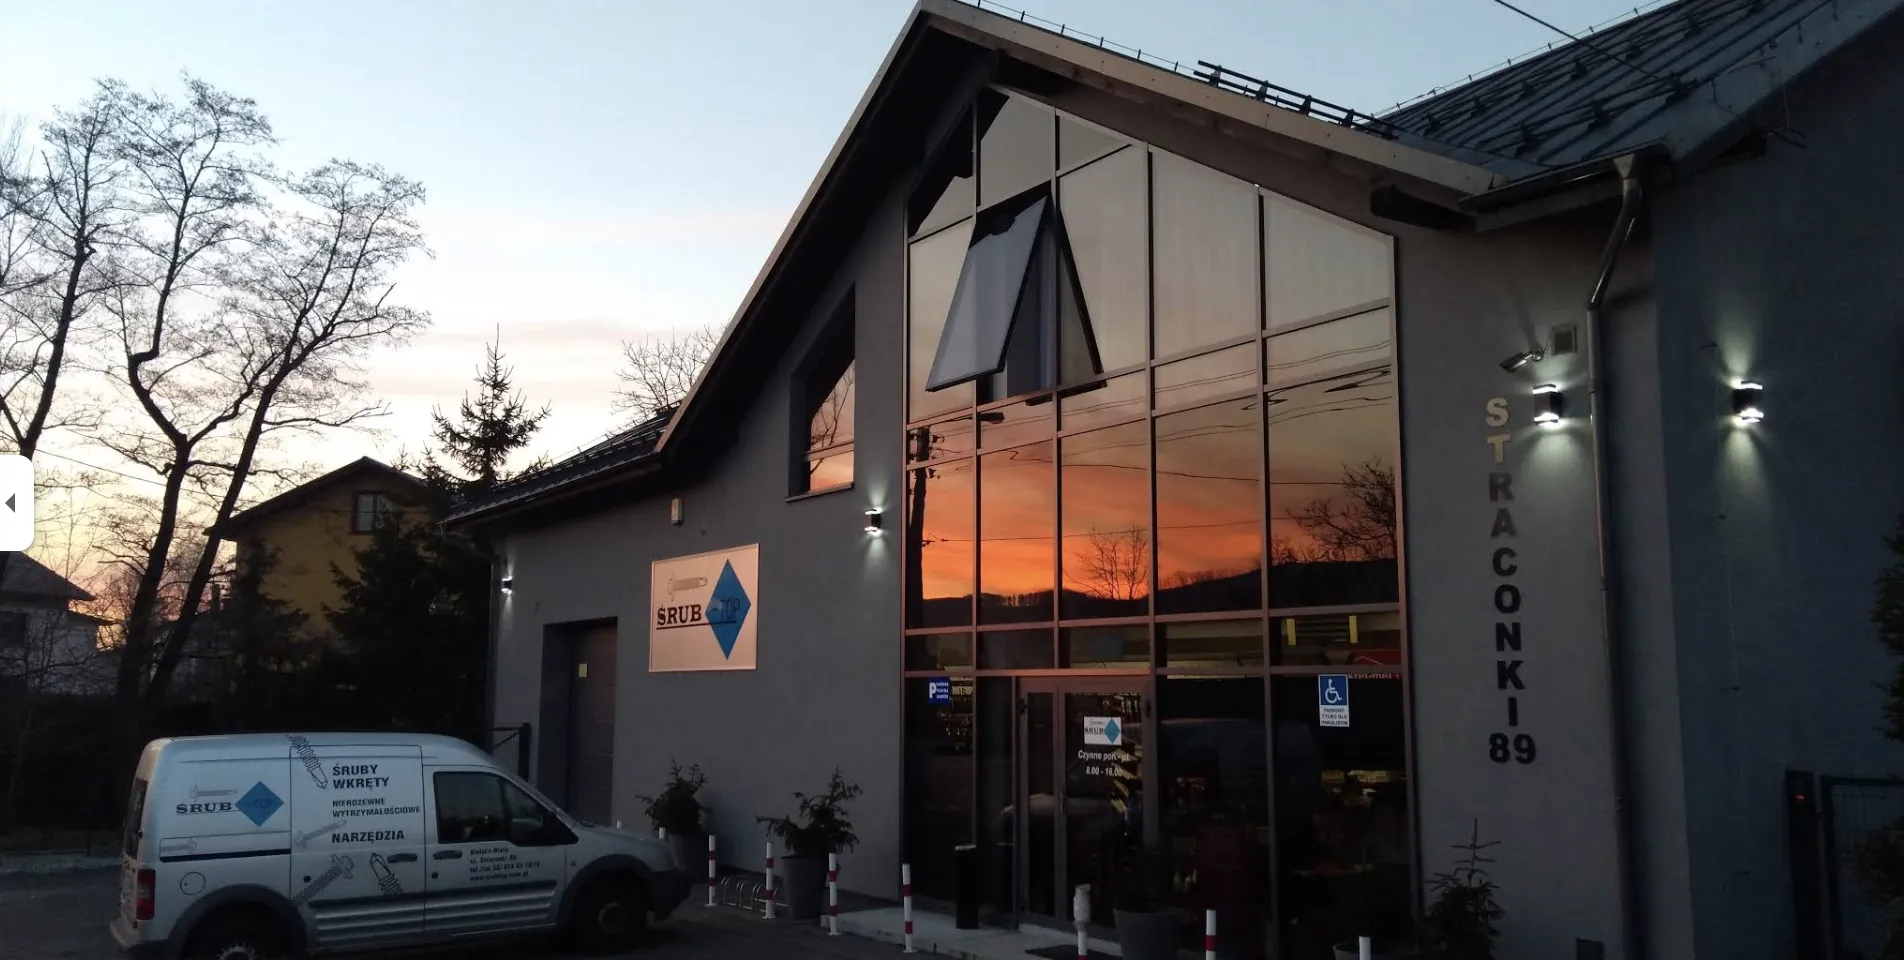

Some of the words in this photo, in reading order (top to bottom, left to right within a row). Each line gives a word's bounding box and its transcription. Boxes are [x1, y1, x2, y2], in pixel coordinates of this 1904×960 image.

[1486, 397, 1525, 727] STRACONKI
[1489, 732, 1537, 765] 89
[1078, 750, 1102, 761] Czynne
[332, 762, 378, 776] ŚRUBY
[1086, 766, 1099, 775] 8.00
[332, 777, 390, 790] WKRĘTY
[332, 798, 386, 807] NIERDZEWNE
[332, 830, 405, 844] NARZĘDZIA
